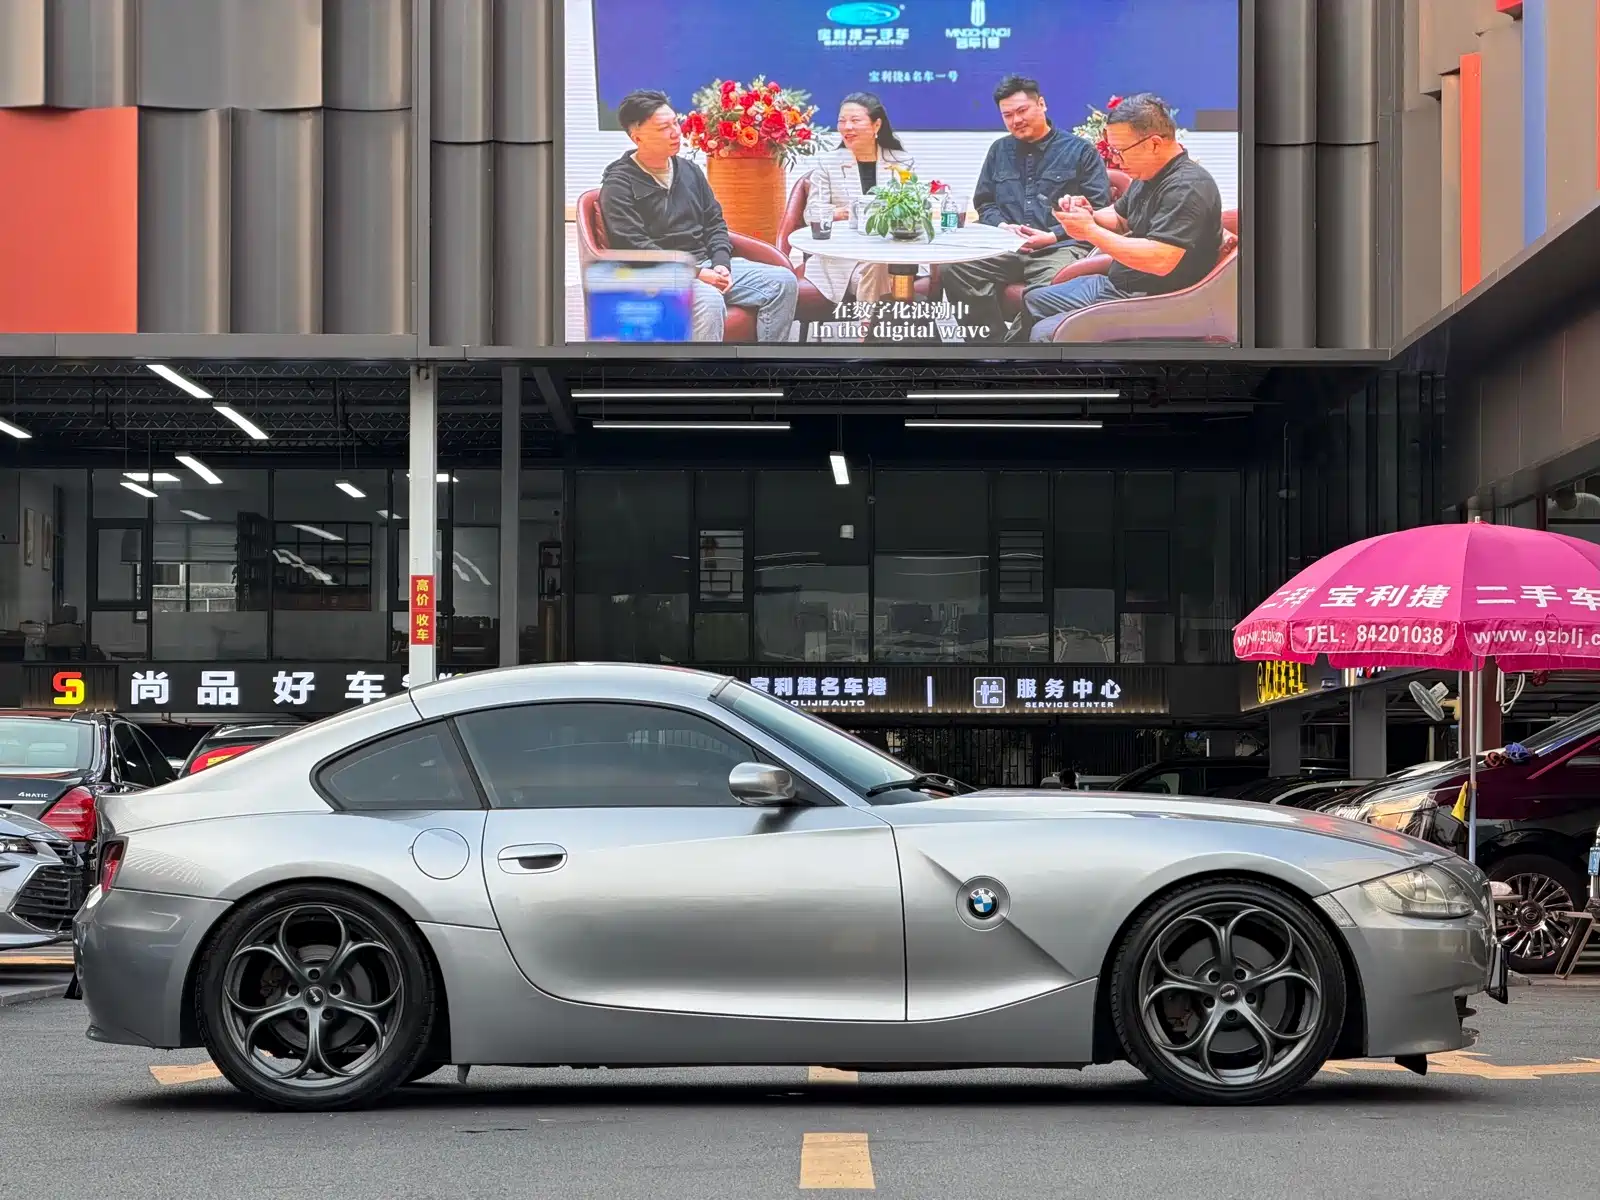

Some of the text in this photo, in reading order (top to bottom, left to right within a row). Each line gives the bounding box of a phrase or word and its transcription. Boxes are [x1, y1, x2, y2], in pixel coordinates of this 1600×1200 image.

[832, 300, 970, 320] 在数字化浪潮中
[812, 320, 990, 341] In the digital wave
[1320, 584, 1600, 611] 宝利捷 二手车
[1305, 625, 1444, 645] TEL: 84201038
[1016, 678, 1122, 699] 服务中心
